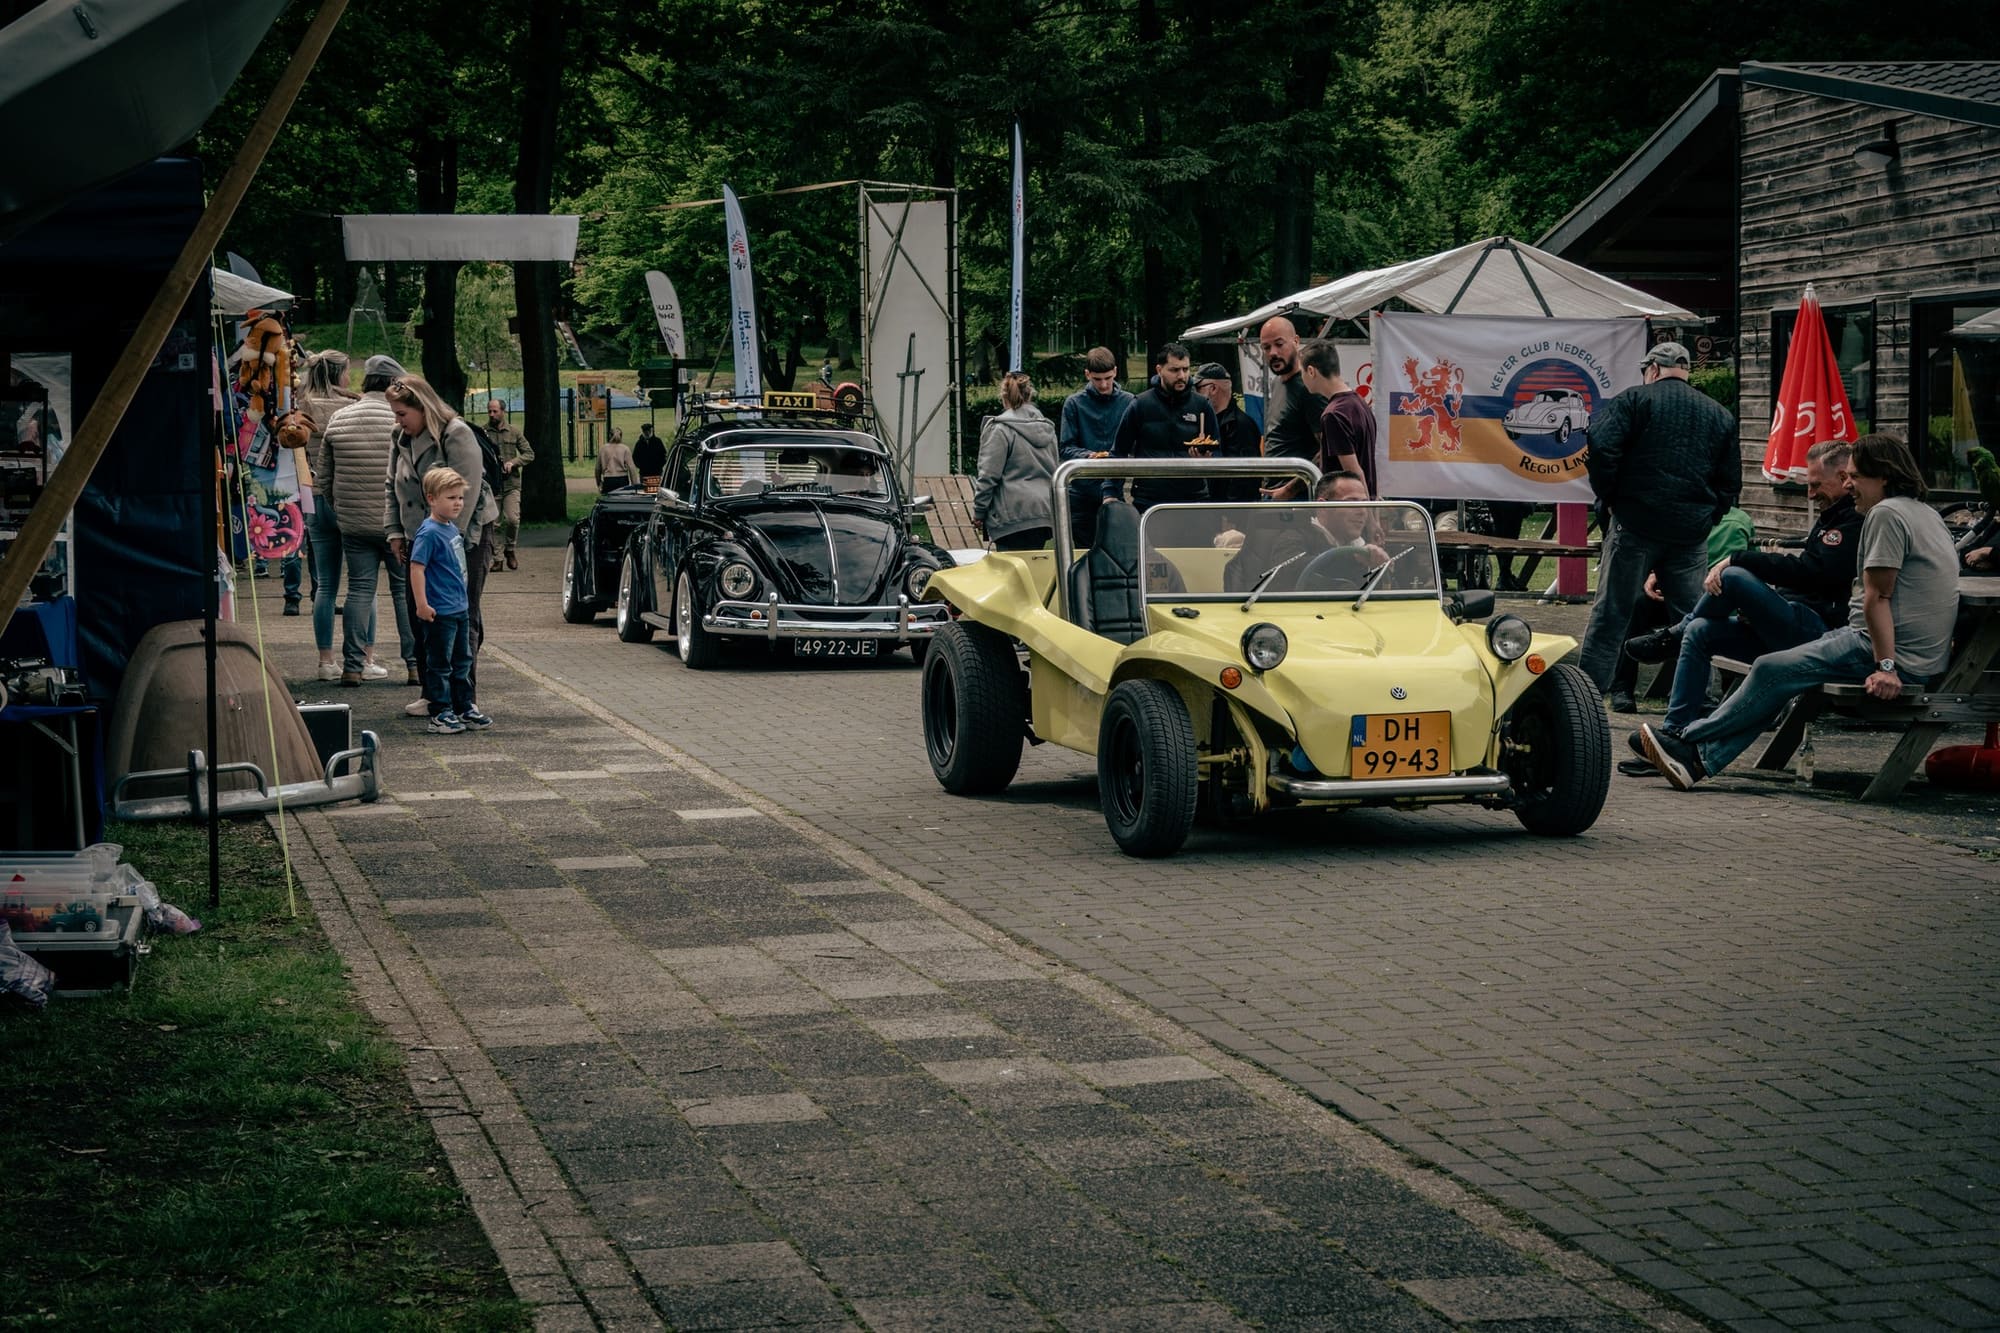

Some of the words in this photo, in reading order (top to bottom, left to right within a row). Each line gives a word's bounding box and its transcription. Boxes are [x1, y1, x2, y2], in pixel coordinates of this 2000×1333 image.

[1490, 355, 1519, 391] KEVER
[1520, 341, 1550, 358] CLUB
[1555, 342, 1611, 390] NEDERLAND
[774, 396, 808, 407] TAXI
[1519, 455, 1560, 474] REGIO
[1384, 717, 1420, 742] DH
[1364, 748, 1439, 775] 99-43
